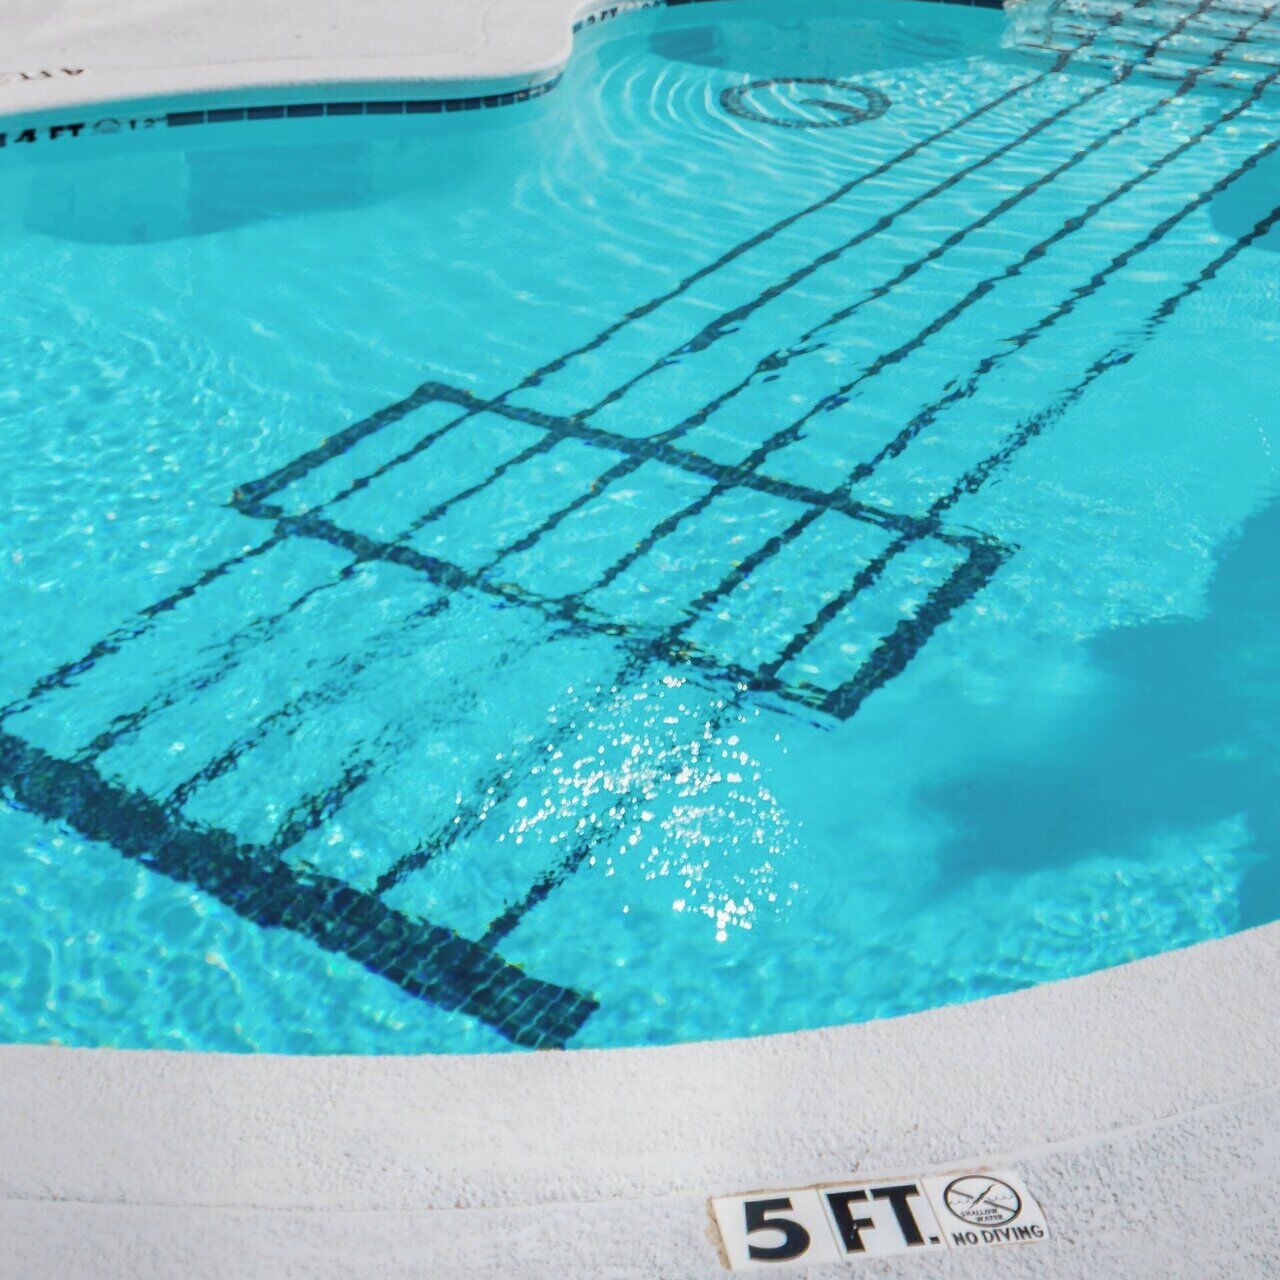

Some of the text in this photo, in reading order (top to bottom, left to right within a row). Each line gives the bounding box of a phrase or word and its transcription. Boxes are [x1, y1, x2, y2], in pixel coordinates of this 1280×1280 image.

[743, 1183, 941, 1262] 5 FT.
[952, 1224, 1045, 1246] NO DIVING
